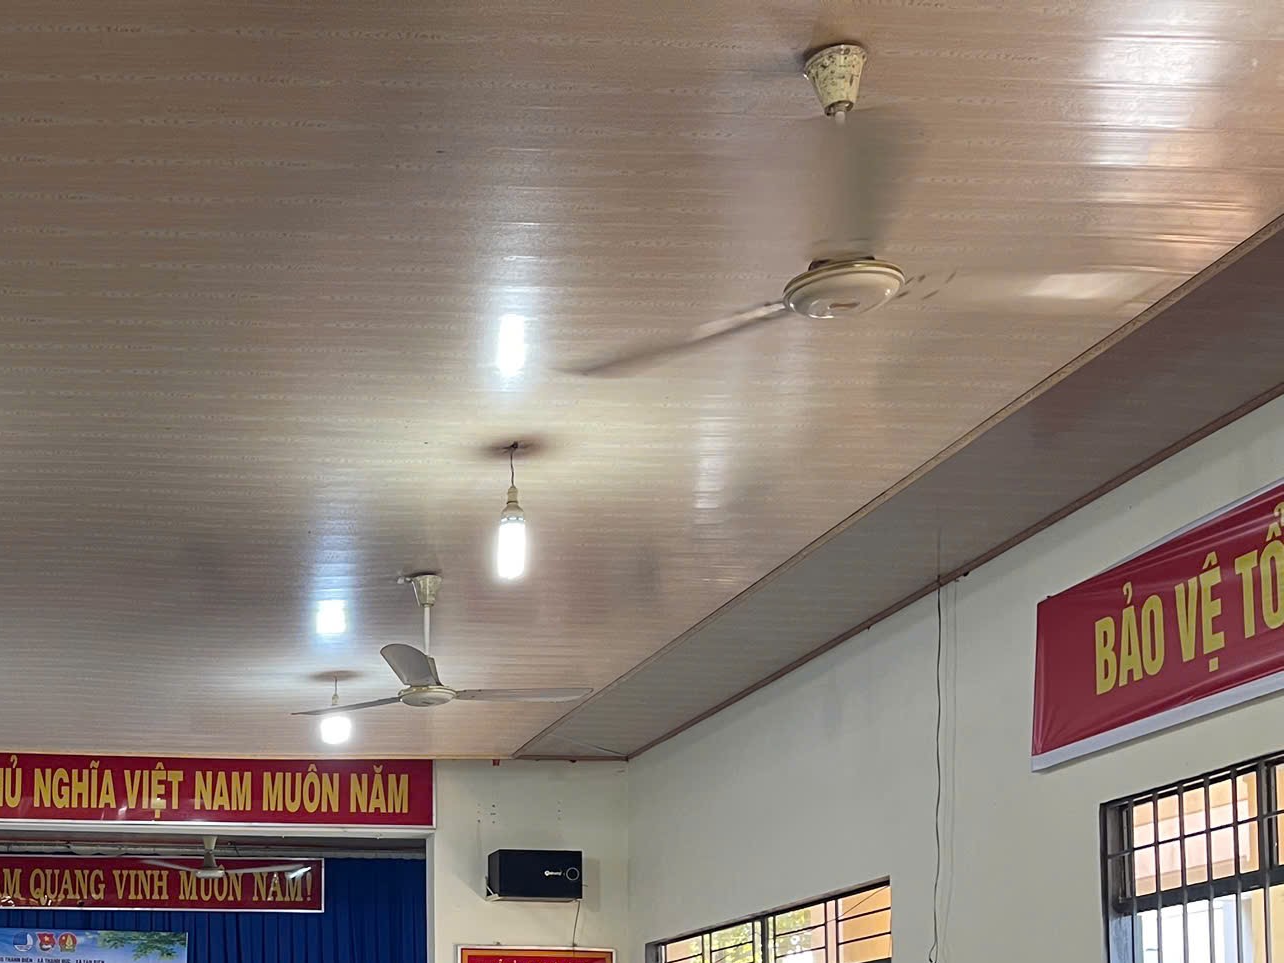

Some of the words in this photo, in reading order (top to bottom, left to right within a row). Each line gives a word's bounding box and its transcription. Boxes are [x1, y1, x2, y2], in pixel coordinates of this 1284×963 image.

[1095, 581, 1165, 695] BẢO
[1174, 551, 1225, 672] VỆ
[33, 760, 116, 809] NGHĨA
[124, 762, 183, 819] VIỆT
[194, 770, 252, 811] NAM
[262, 763, 340, 813] MUÔN
[349, 764, 409, 814] NĂM
[30, 868, 106, 902] QUANG
[116, 869, 169, 900] VINH
[179, 864, 243, 902] MUÔN
